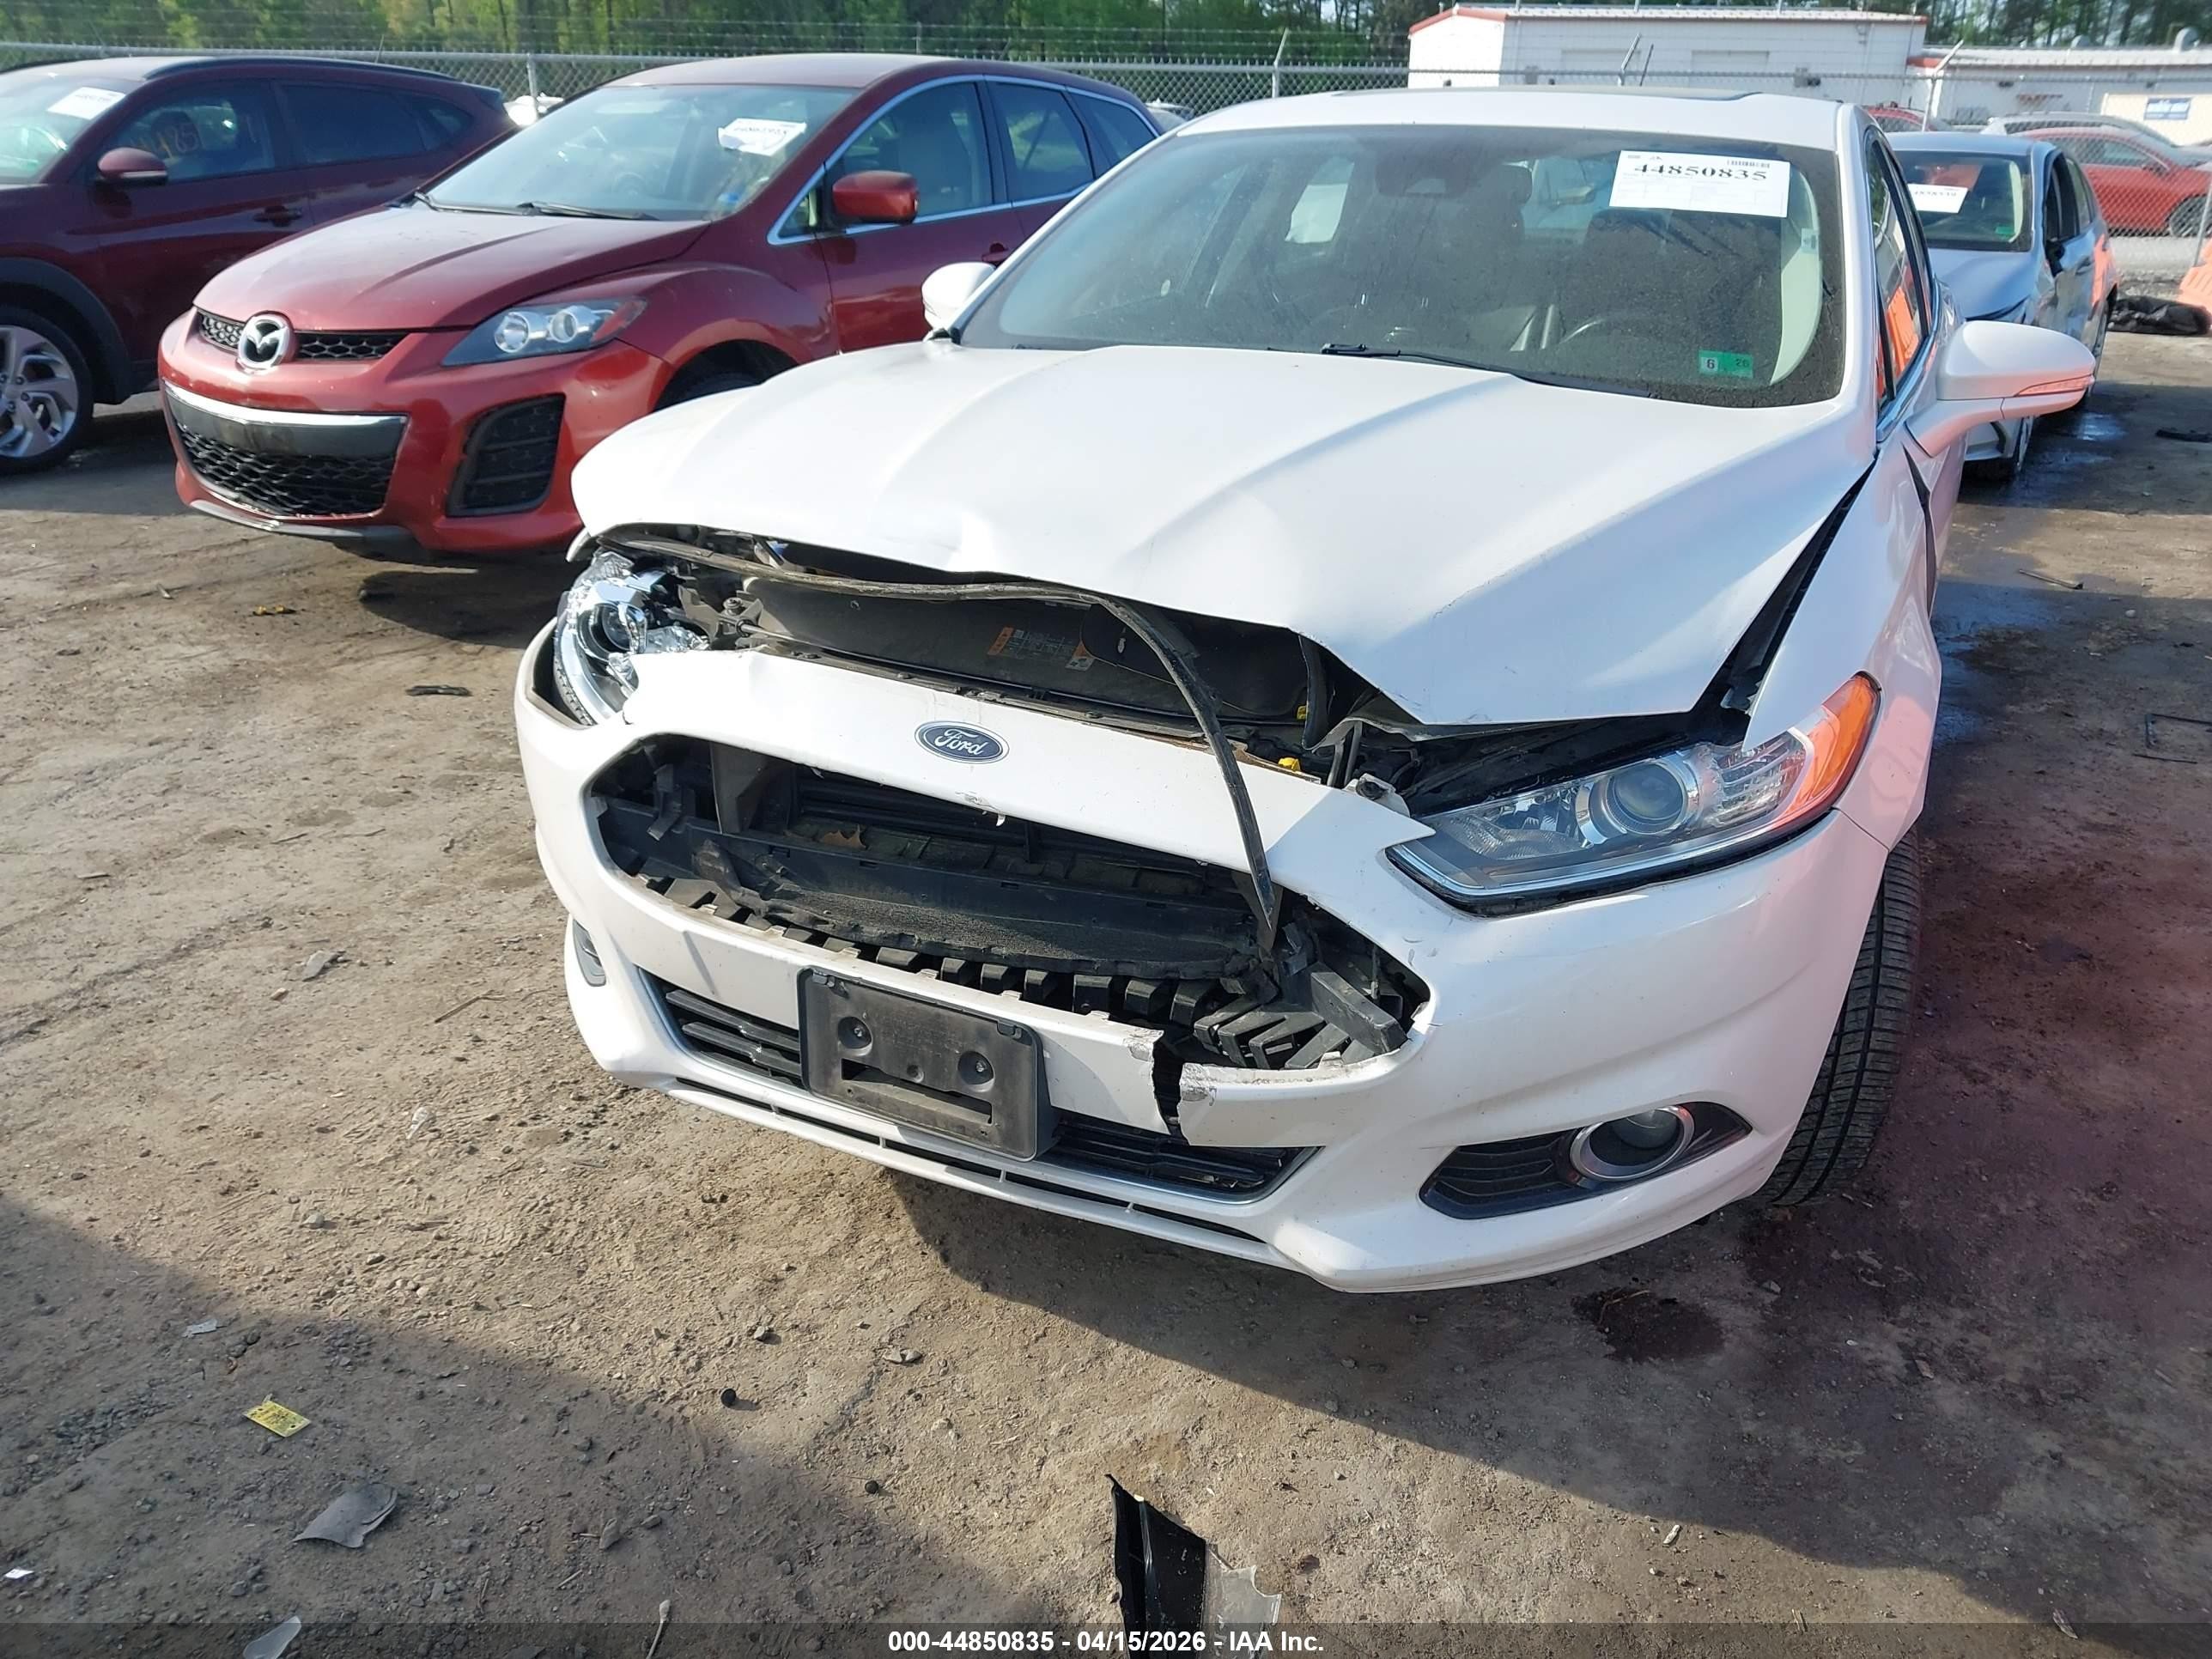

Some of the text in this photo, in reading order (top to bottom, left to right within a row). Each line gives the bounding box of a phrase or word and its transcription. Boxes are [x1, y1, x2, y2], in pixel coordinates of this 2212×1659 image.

[1634, 163, 1767, 181] 44850835
[1706, 358, 1715, 369] 6
[934, 728, 988, 755] Ford
